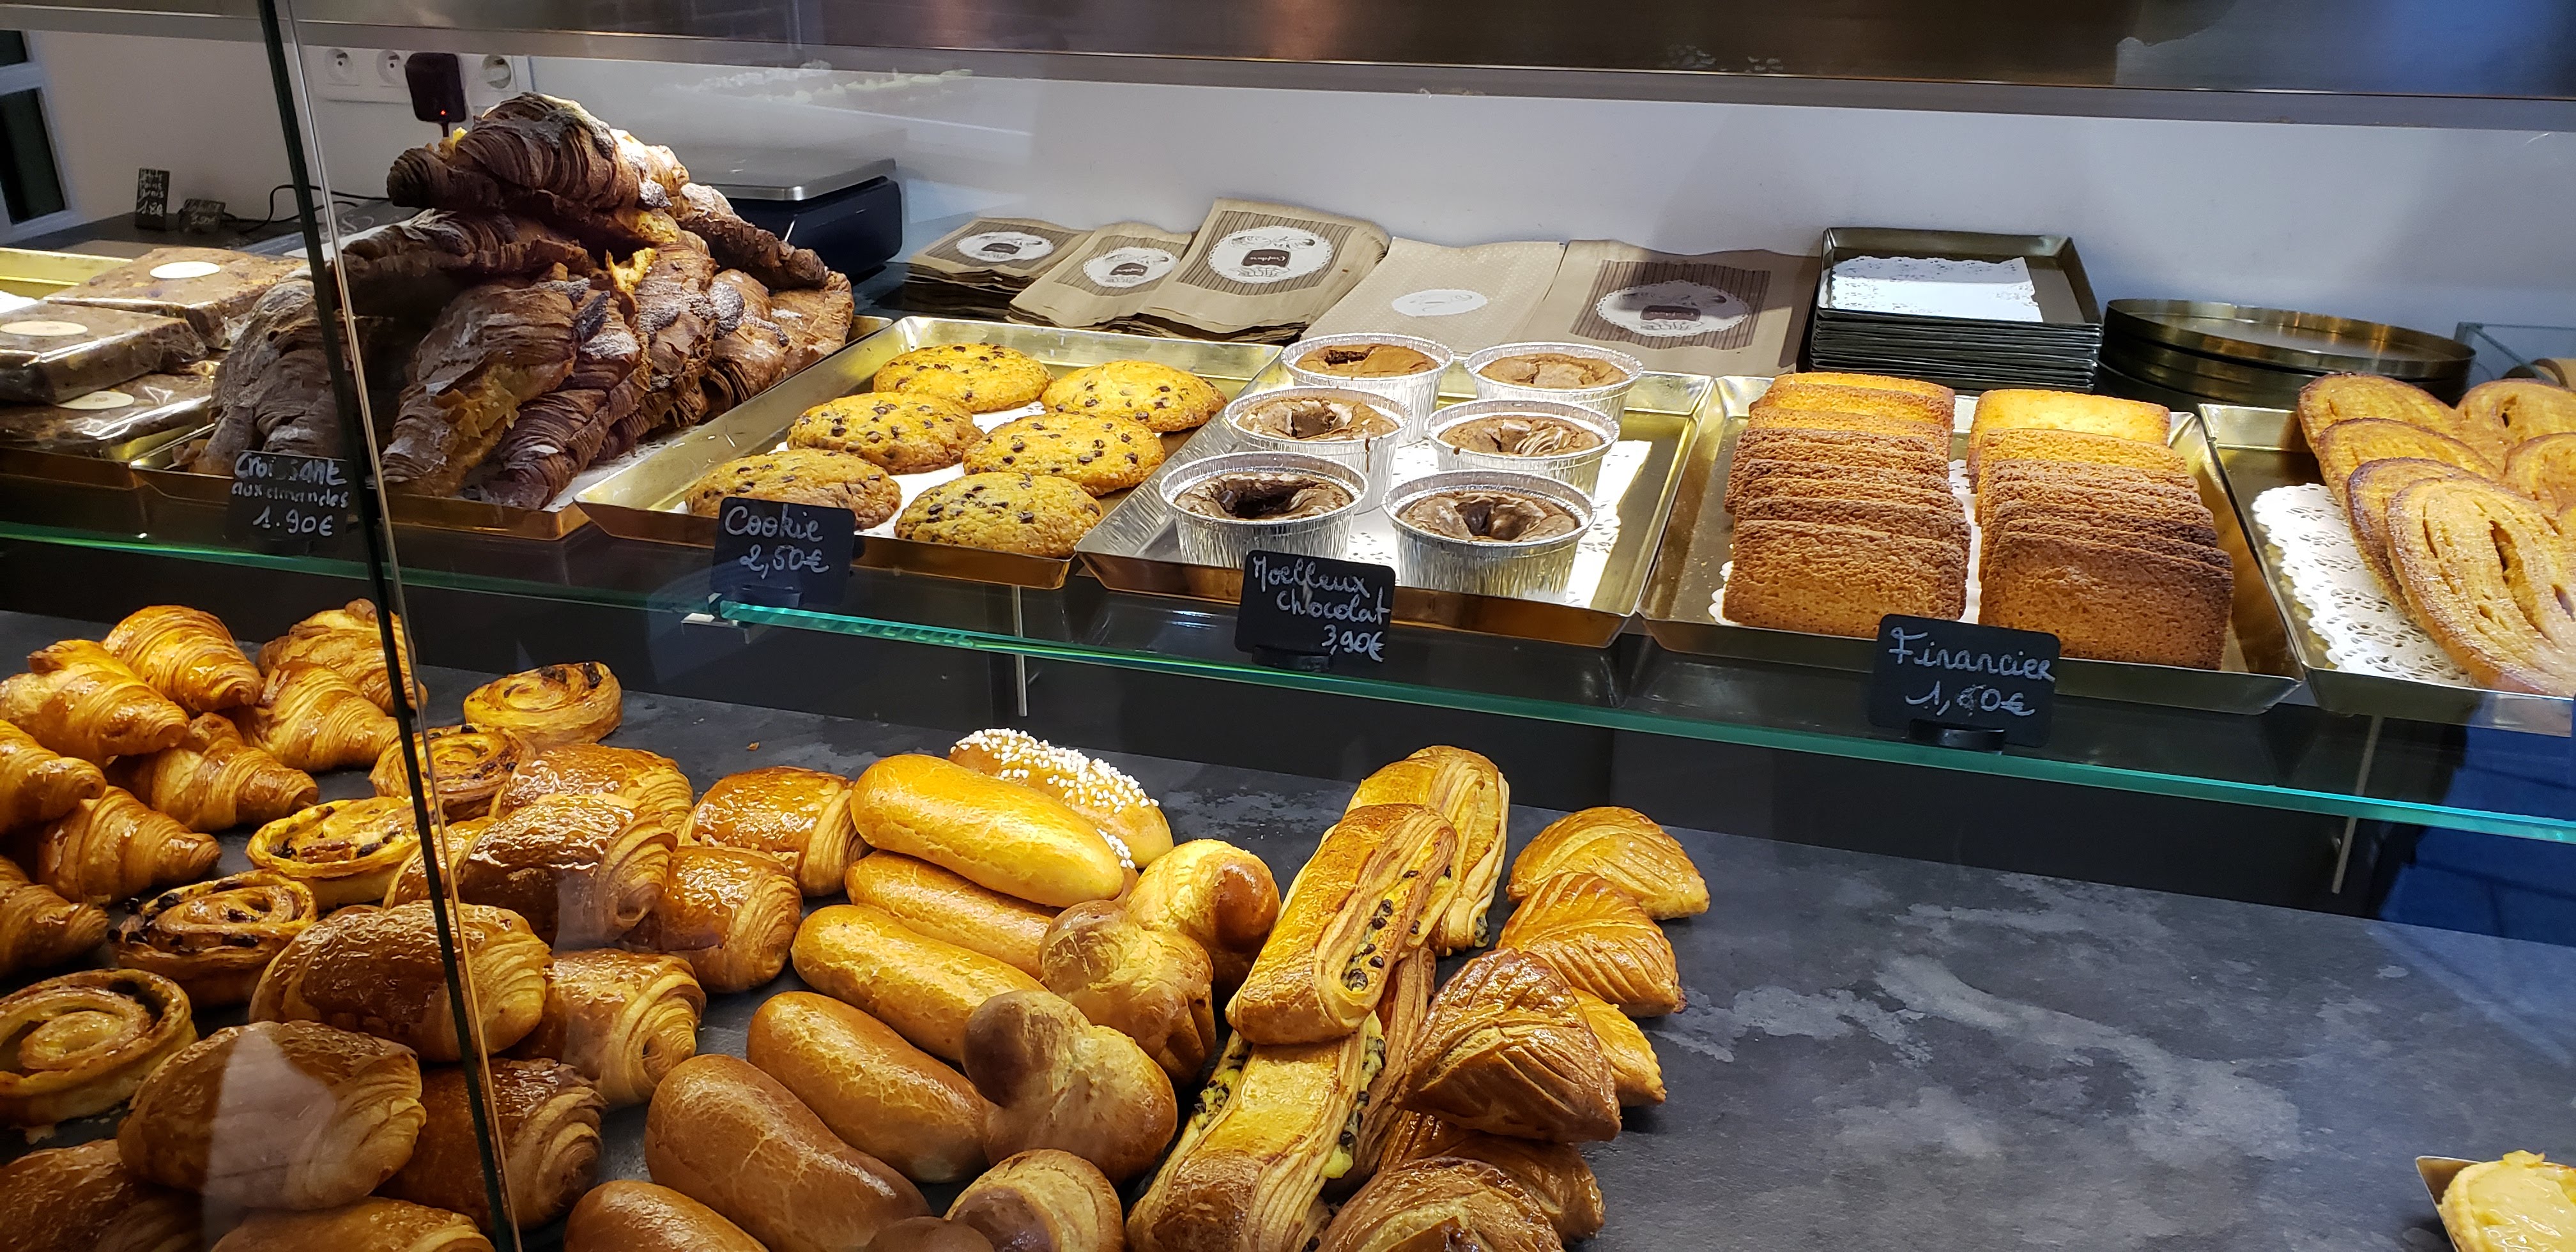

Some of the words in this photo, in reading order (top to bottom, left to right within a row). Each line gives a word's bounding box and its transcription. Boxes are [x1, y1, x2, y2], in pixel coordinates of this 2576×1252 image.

[724, 503, 824, 542] Cookie
[739, 544, 830, 580] 2,50€
[1321, 623, 1385, 662] 3,90€
[1888, 626, 2056, 682] Financier
